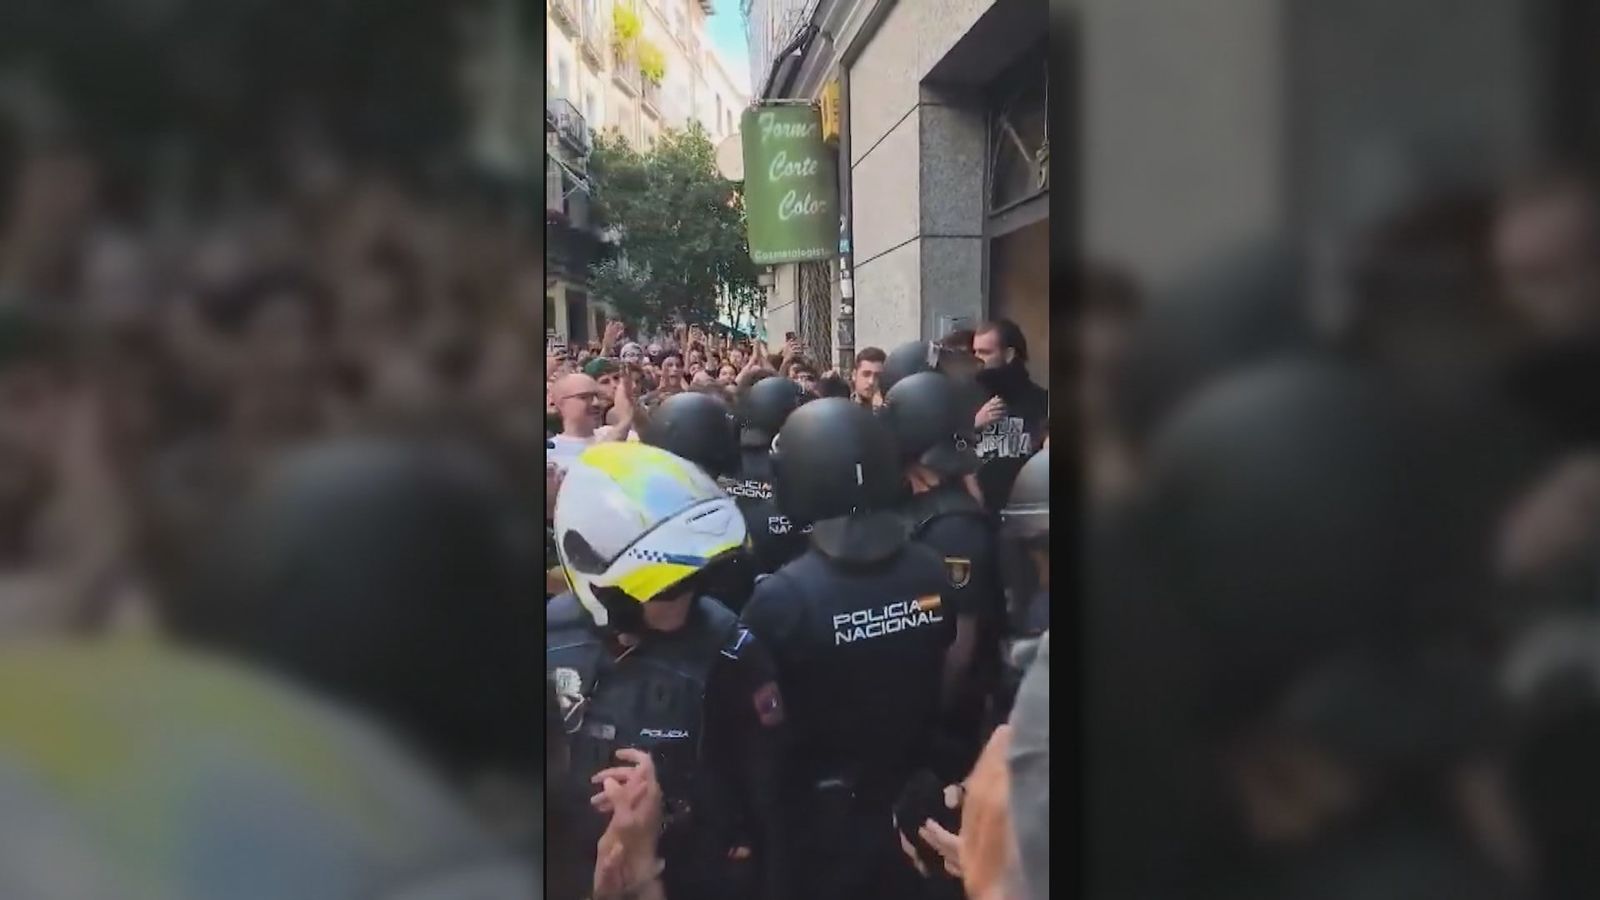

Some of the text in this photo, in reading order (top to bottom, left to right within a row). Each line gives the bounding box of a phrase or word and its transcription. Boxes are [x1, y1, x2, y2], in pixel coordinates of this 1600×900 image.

[768, 150, 818, 181] Corte
[833, 600, 922, 629] POLICIA
[834, 609, 943, 646] NACIONAL
